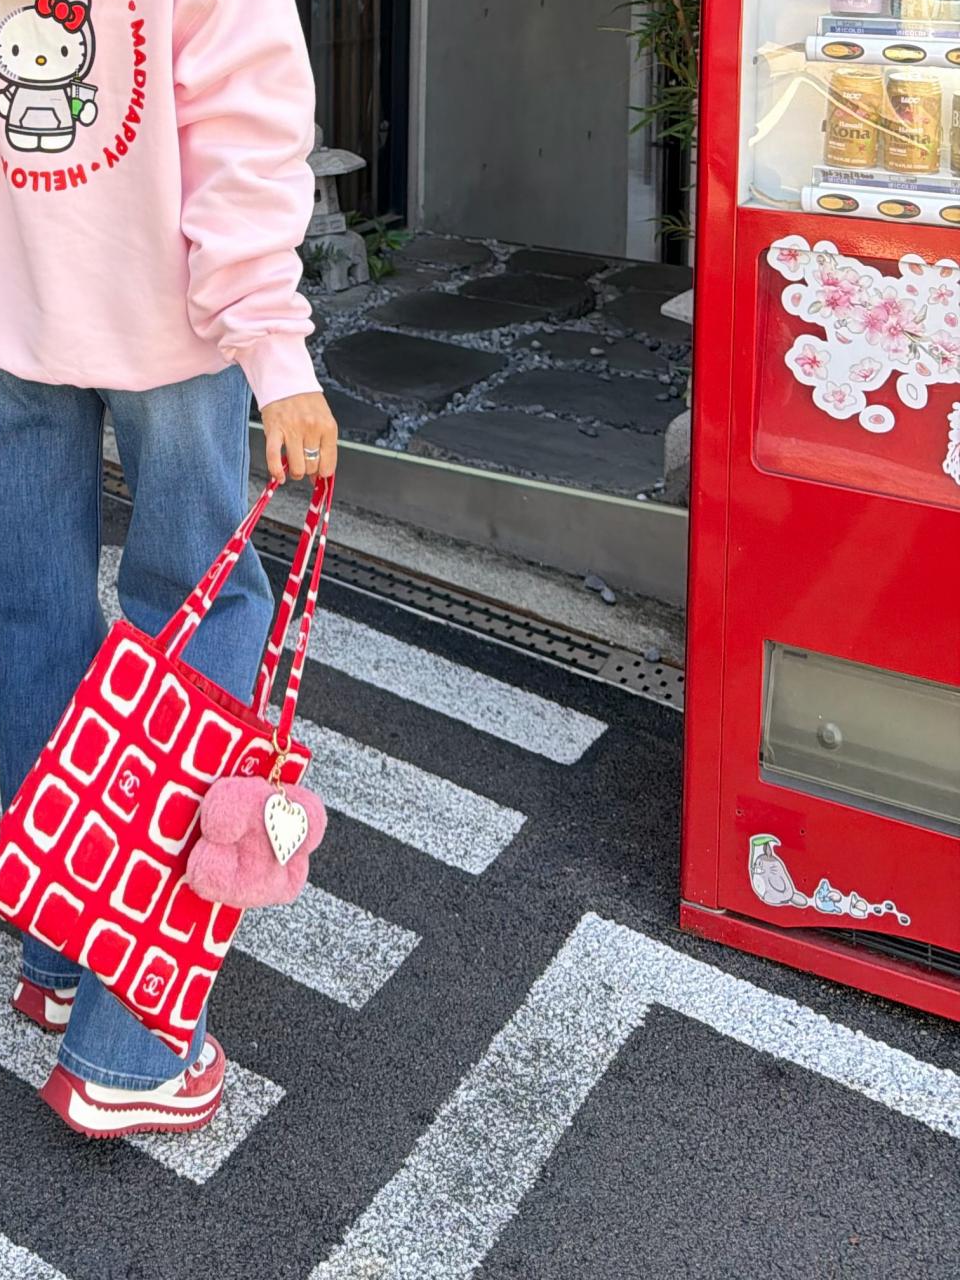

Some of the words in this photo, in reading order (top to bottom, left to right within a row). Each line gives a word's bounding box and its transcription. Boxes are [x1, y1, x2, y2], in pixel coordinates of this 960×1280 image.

[103, 19, 147, 168] MADHAPPY
[829, 123, 871, 139] Kona
[11, 163, 88, 192] HELLO
